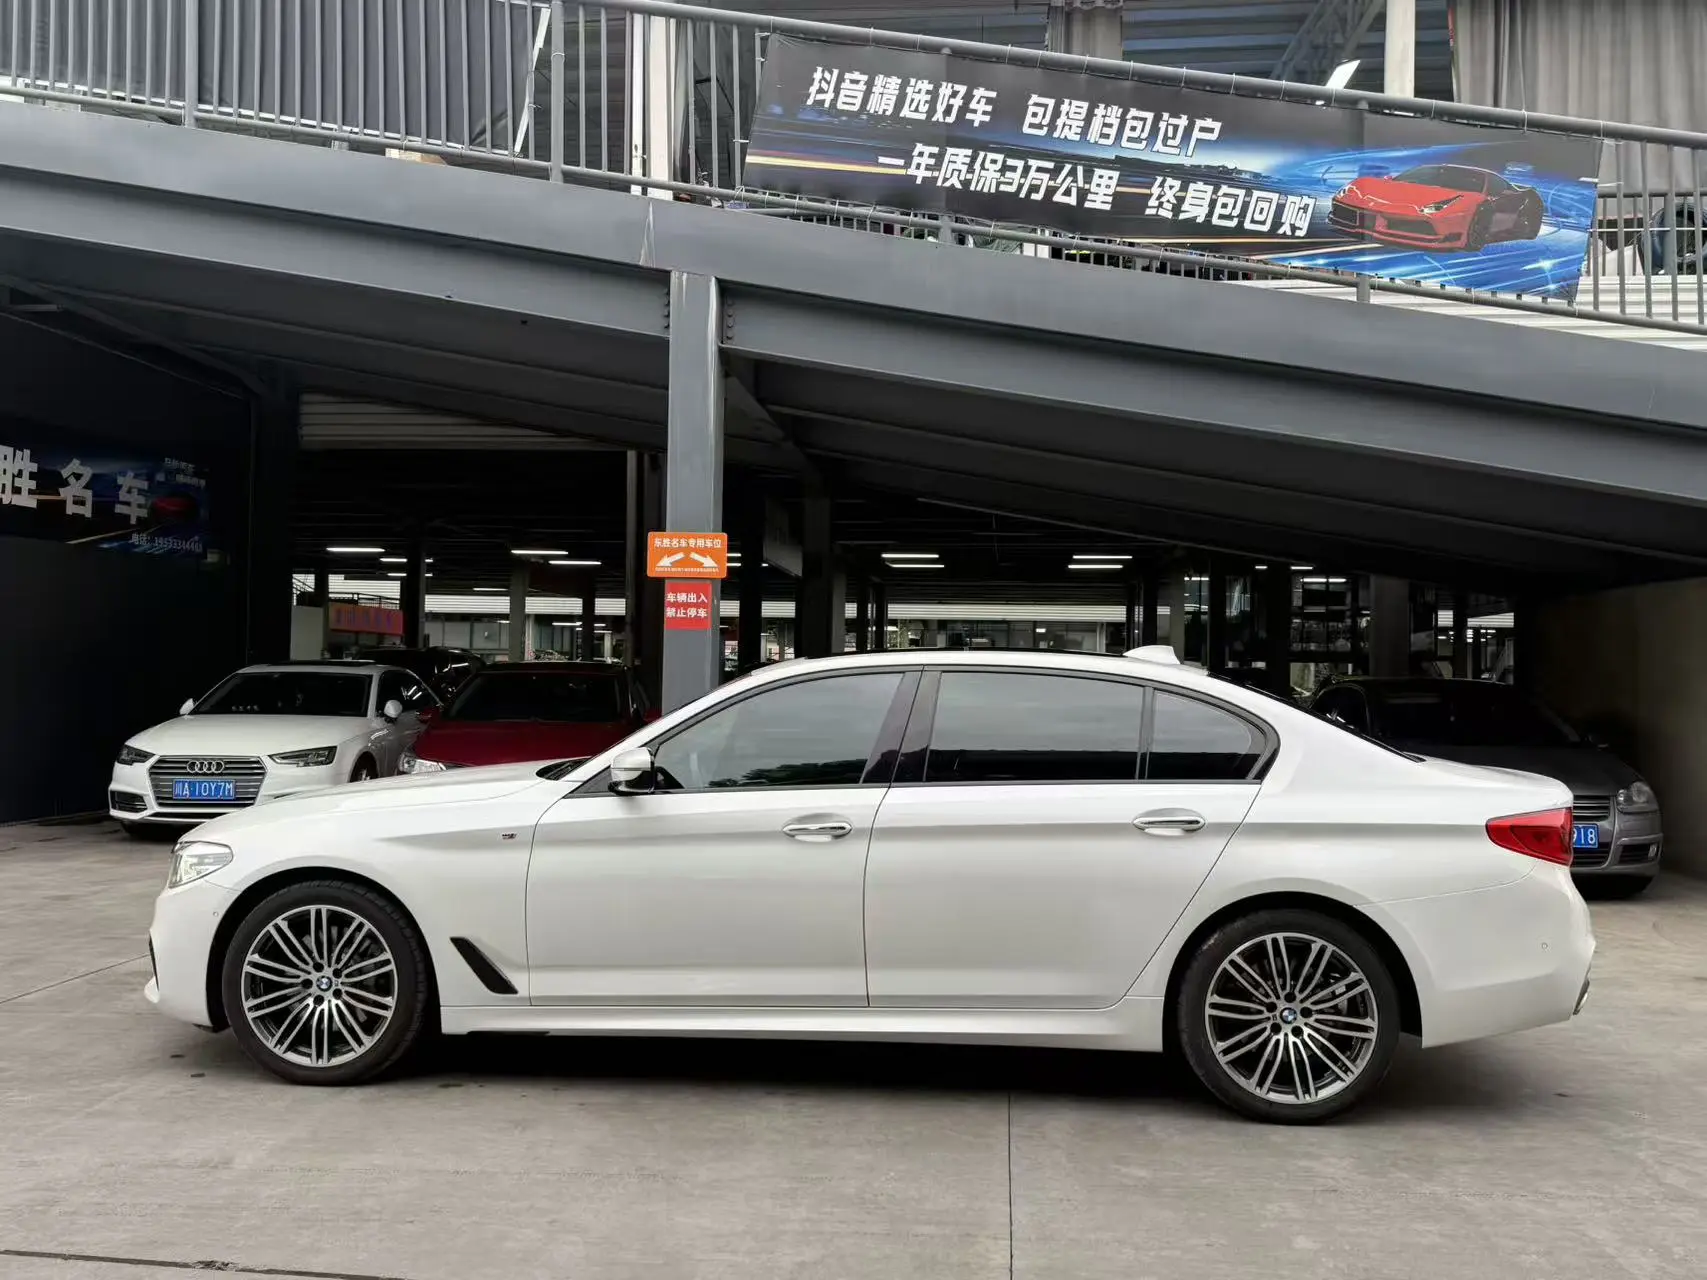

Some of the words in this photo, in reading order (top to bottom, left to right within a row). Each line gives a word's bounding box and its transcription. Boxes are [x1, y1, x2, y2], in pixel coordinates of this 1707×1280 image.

[806, 66, 998, 127] 抖音精选好车
[1022, 93, 1222, 158] 包提档包过户
[877, 142, 1121, 211] 一年质保3万公里
[1144, 175, 1317, 237] 终身包回购
[666, 592, 708, 603] 车辆出入
[666, 607, 708, 618] 禁止停车
